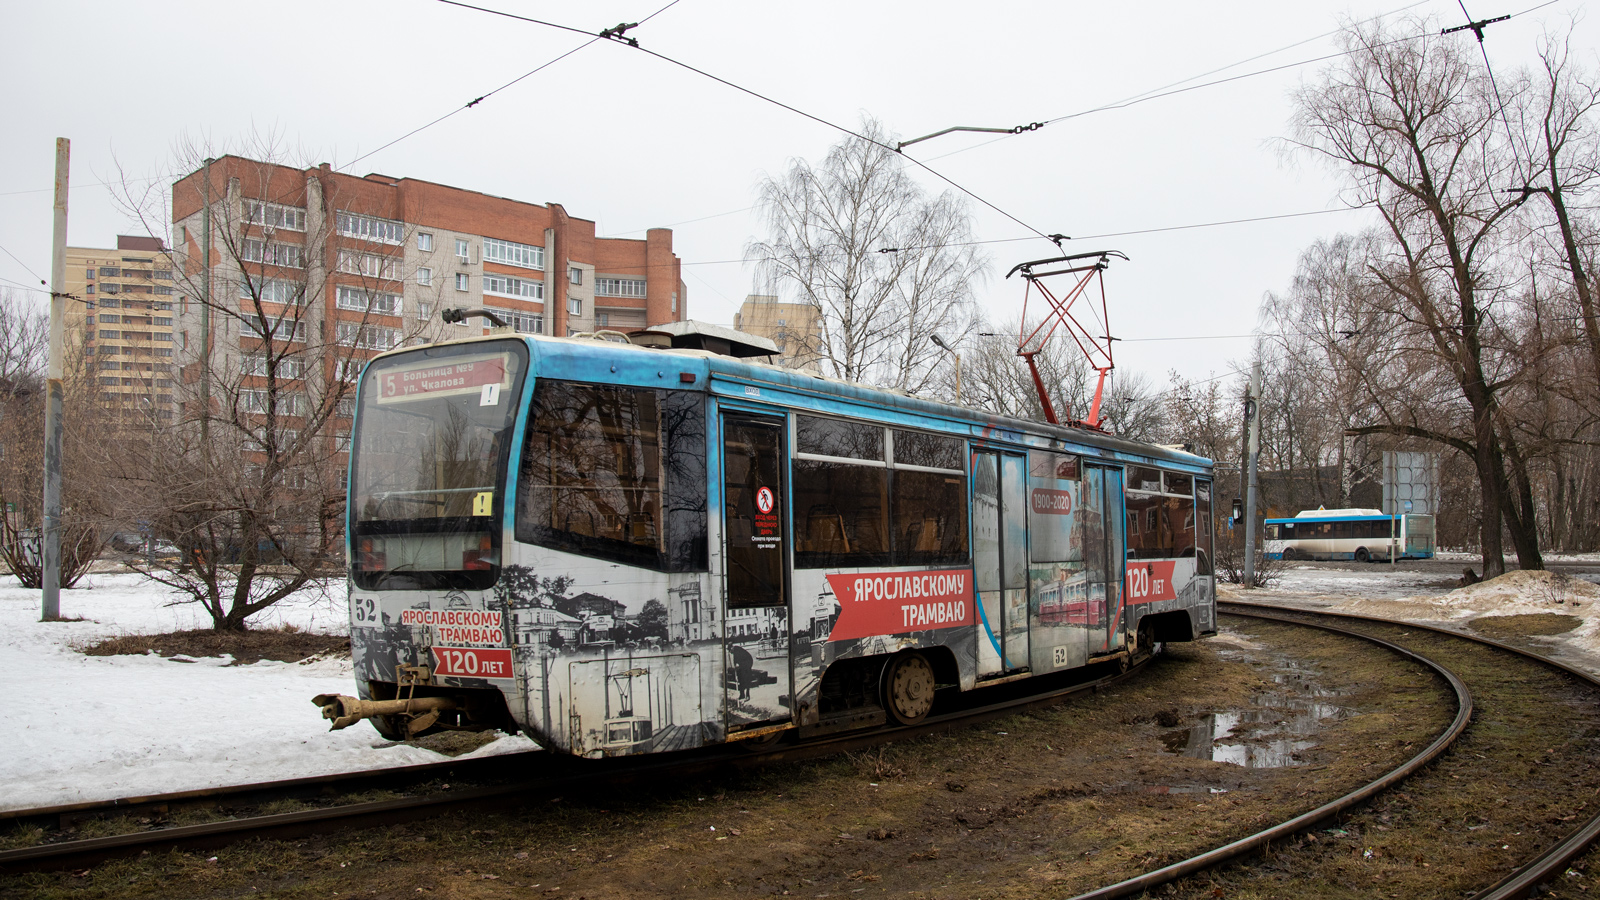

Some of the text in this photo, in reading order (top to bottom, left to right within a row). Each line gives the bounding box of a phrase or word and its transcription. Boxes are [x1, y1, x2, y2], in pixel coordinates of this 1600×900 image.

[403, 367, 453, 381] Больница
[386, 375, 396, 396] 5
[403, 377, 465, 395] ул. Чкалова
[1033, 493, 1070, 510] 1900-2020
[854, 574, 965, 602] ЯРОСЛАВСКОМУ
[1127, 567, 1165, 598] 120 ЛЕТ
[355, 598, 377, 622] 52
[402, 610, 502, 626] ЯРОСЛАВСКОМУ
[901, 600, 965, 627] ТРАМВАЮ
[438, 627, 503, 643] ТРАМВАЮ
[442, 650, 504, 674] 120 ЛЕТ
[1055, 648, 1065, 664] 52
